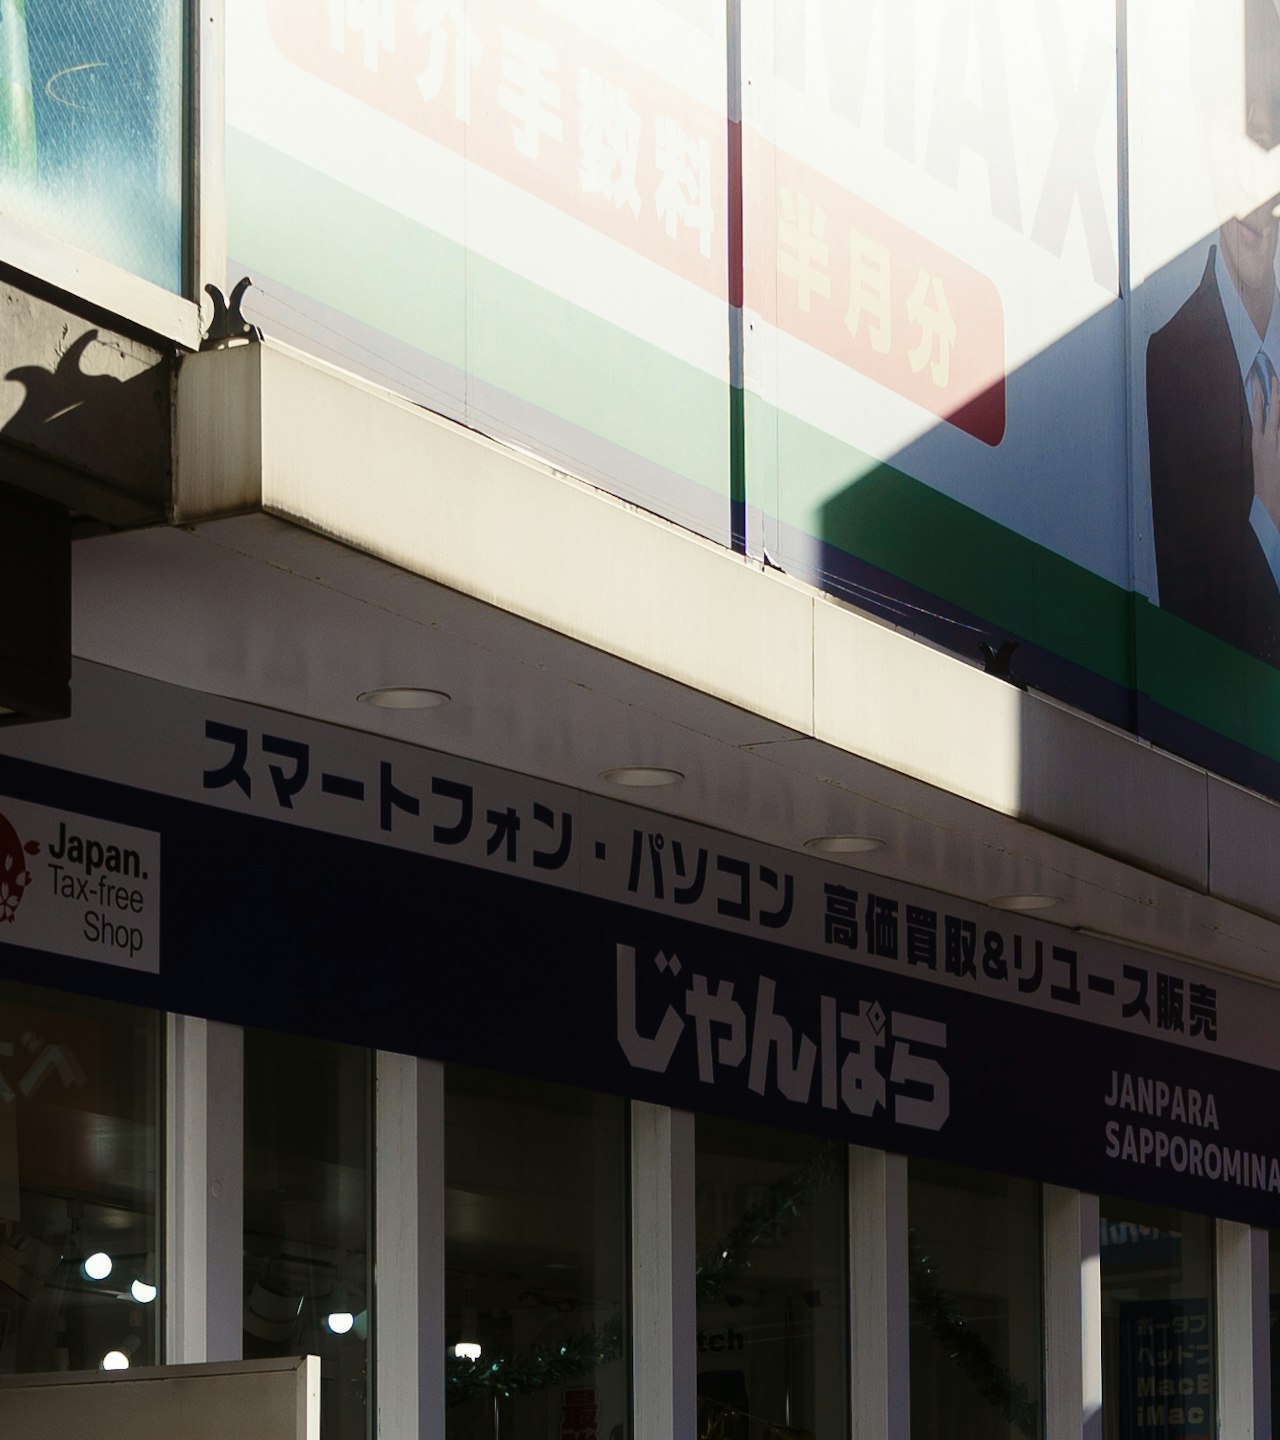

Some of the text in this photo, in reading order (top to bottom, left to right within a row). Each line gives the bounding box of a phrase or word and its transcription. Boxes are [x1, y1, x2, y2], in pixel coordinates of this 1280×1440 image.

[775, 188, 960, 392] 半月分
[49, 863, 144, 914] Tax-free
[82, 910, 144, 958] Shop
[822, 882, 1218, 1042] 高価買取&リユース販売
[616, 942, 951, 1132] じゃんぱら
[1104, 1070, 1220, 1132] JANPARA
[1137, 1404, 1205, 1428] iMac
